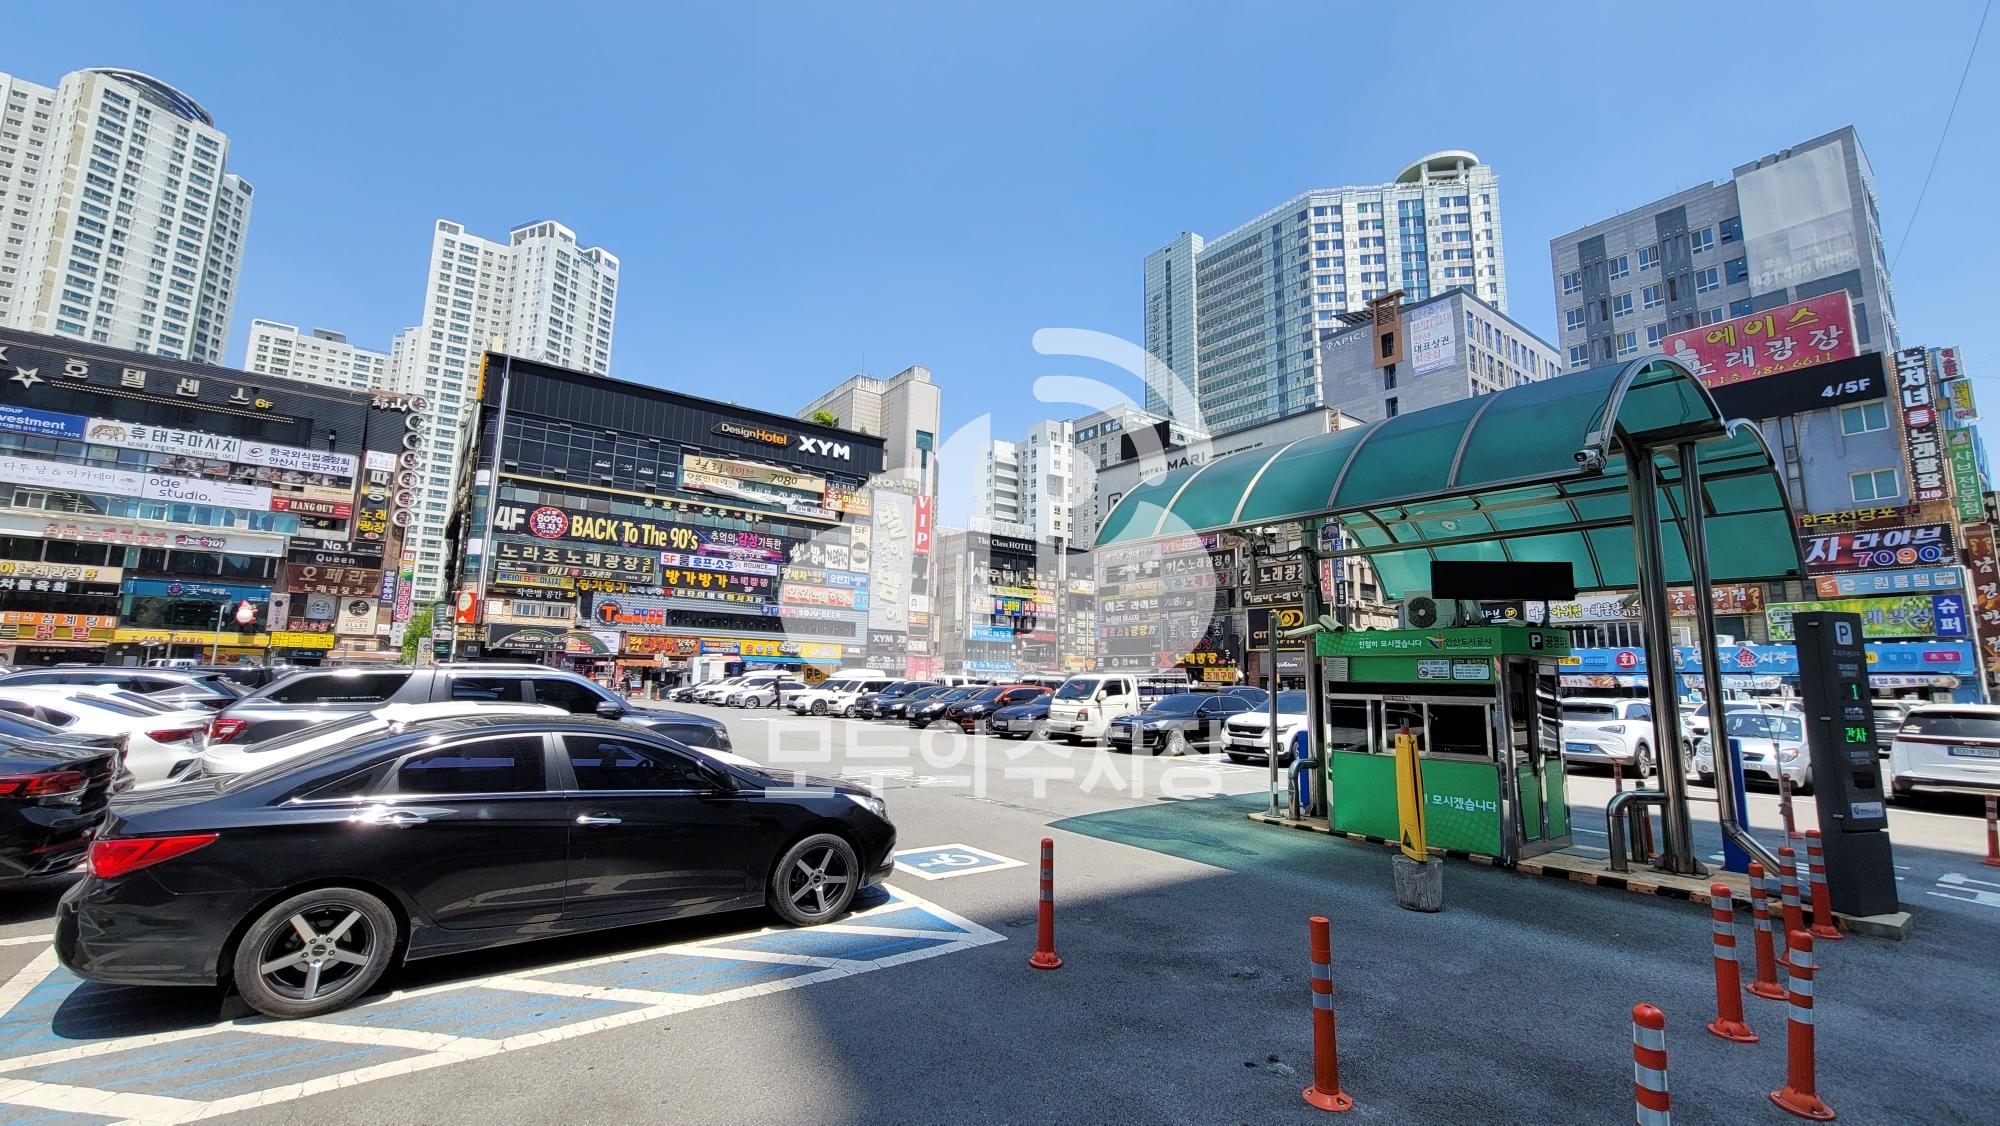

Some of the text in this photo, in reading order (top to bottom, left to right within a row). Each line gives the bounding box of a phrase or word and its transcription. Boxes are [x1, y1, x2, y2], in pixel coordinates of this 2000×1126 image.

[1705, 306, 1821, 348] 에이스
[1413, 335, 1451, 354] 대표상권
[1751, 351, 1833, 378] 484-6611
[1820, 377, 1871, 399] 4/5F
[254, 398, 274, 409] 6F
[130, 426, 147, 440] 휴
[151, 429, 237, 453] 태국마사지
[798, 435, 851, 461] XYM
[268, 456, 349, 475] 안산시 단원구지부
[269, 446, 351, 466] 한국외식업중앙회
[1139, 451, 1205, 477] HOTEL MARI
[150, 477, 181, 488] ode
[768, 473, 798, 486] 7080
[159, 488, 212, 502] studio.
[290, 500, 335, 514] HANG OUT
[317, 520, 330, 528] 4F
[494, 506, 527, 531] 4F
[917, 495, 931, 546] VIP
[1801, 507, 1896, 528] 한국전당포
[570, 514, 699, 550] BACK To The 90's
[738, 532, 759, 548] 감성
[758, 537, 783, 551] 가득한
[1851, 527, 1943, 550] 라이브
[977, 535, 1033, 552] The Class HOTEL
[315, 553, 356, 565] Queen
[663, 554, 677, 564] 5F
[1853, 546, 1942, 568] 7090
[299, 566, 368, 586] 오페라
[665, 569, 729, 588] 방가방가
[303, 583, 350, 595] 노래광장
[41, 613, 100, 626] 삼계탕
[1936, 598, 1962, 633] 슈퍼
[873, 634, 894, 643] XYM
[1531, 633, 1543, 648] P
[1838, 624, 1849, 638] P
[1358, 638, 1493, 649] 친절히 모시겠습니다 안산도시공사
[1175, 651, 1218, 665] 노래광장
[1619, 652, 1636, 666] 회
[1204, 670, 1235, 680] 조개구이
[1851, 683, 1861, 700] 1
[1432, 793, 1499, 813] 모시겠습니다
